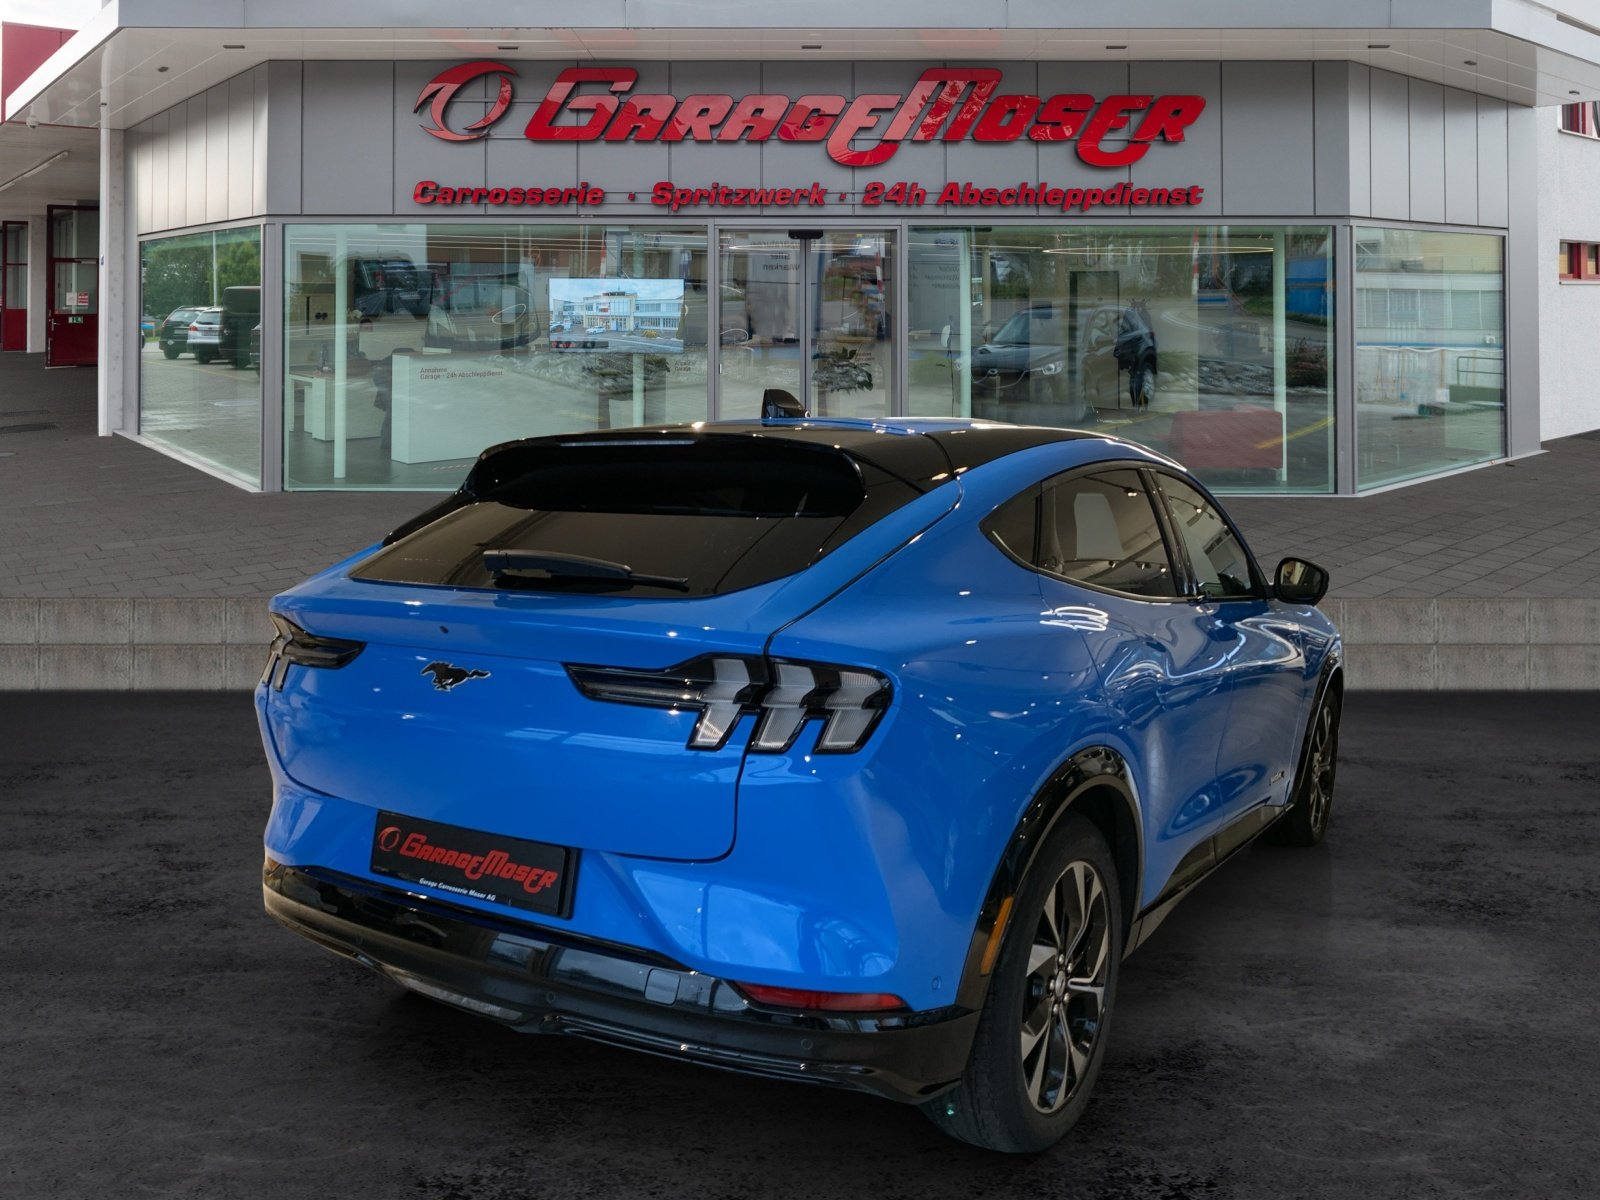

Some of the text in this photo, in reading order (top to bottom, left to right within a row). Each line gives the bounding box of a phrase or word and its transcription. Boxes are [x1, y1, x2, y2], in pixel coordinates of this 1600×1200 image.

[413, 181, 1204, 211] Carrosserie Spritzwerk 24h Abschleppdienst
[419, 877, 438, 888] Garage
[468, 889, 487, 899] Moser
[486, 893, 497, 902] AG
